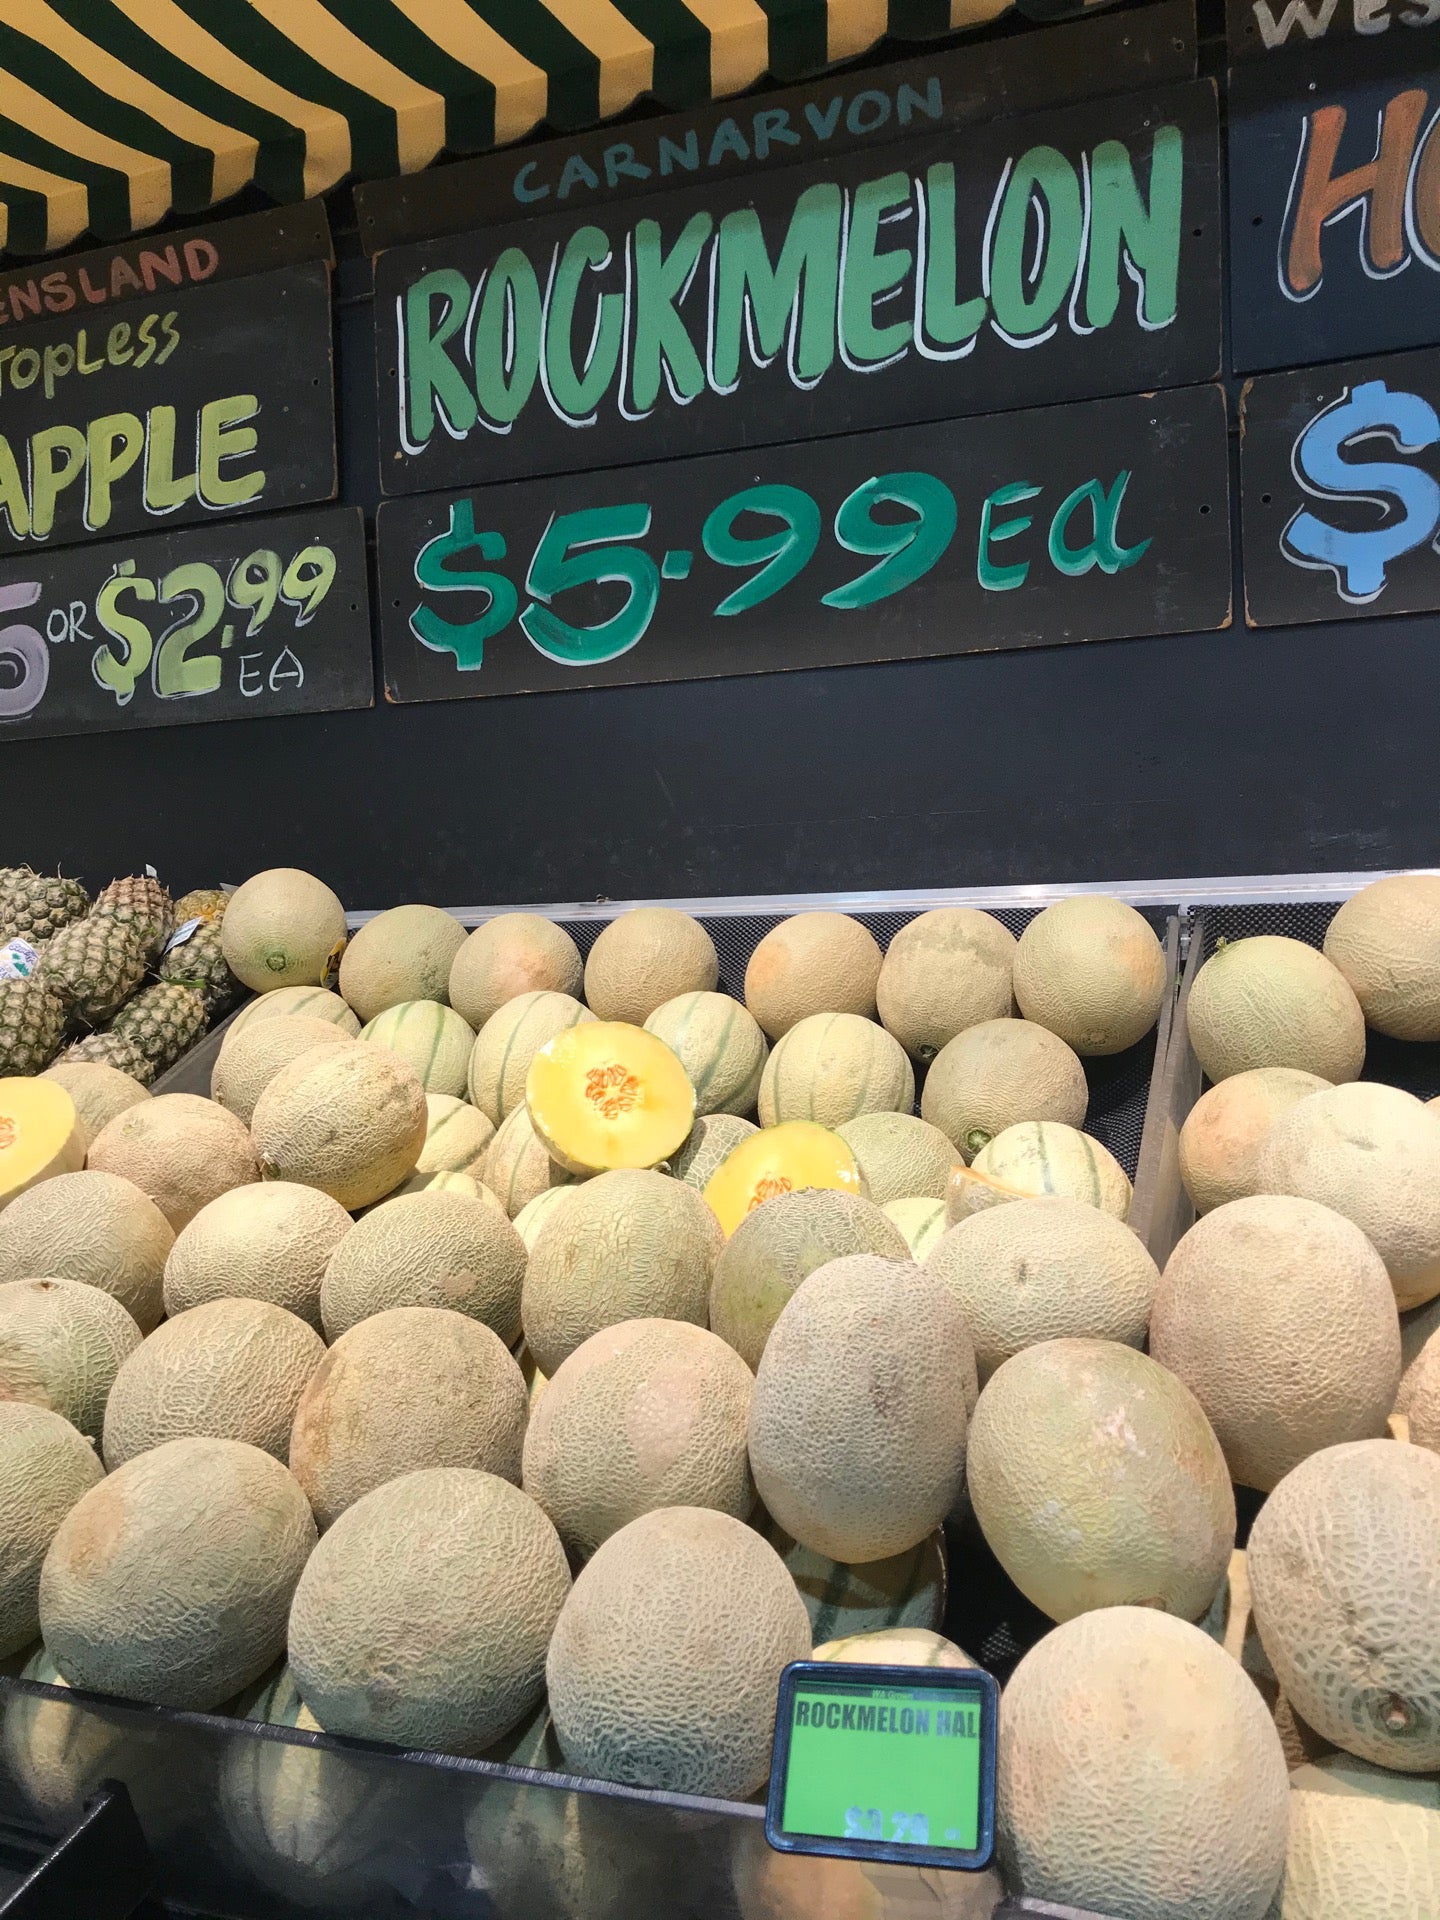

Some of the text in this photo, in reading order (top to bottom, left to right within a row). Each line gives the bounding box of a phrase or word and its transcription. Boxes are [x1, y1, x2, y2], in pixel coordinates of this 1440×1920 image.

[513, 77, 944, 203] CARNARVON
[396, 125, 1184, 456] ROCKMELON
[46, 600, 95, 643] OR
[91, 545, 337, 706] $2.99
[239, 644, 304, 698] EA
[795, 1700, 978, 1739] ROCKMELON HAL
